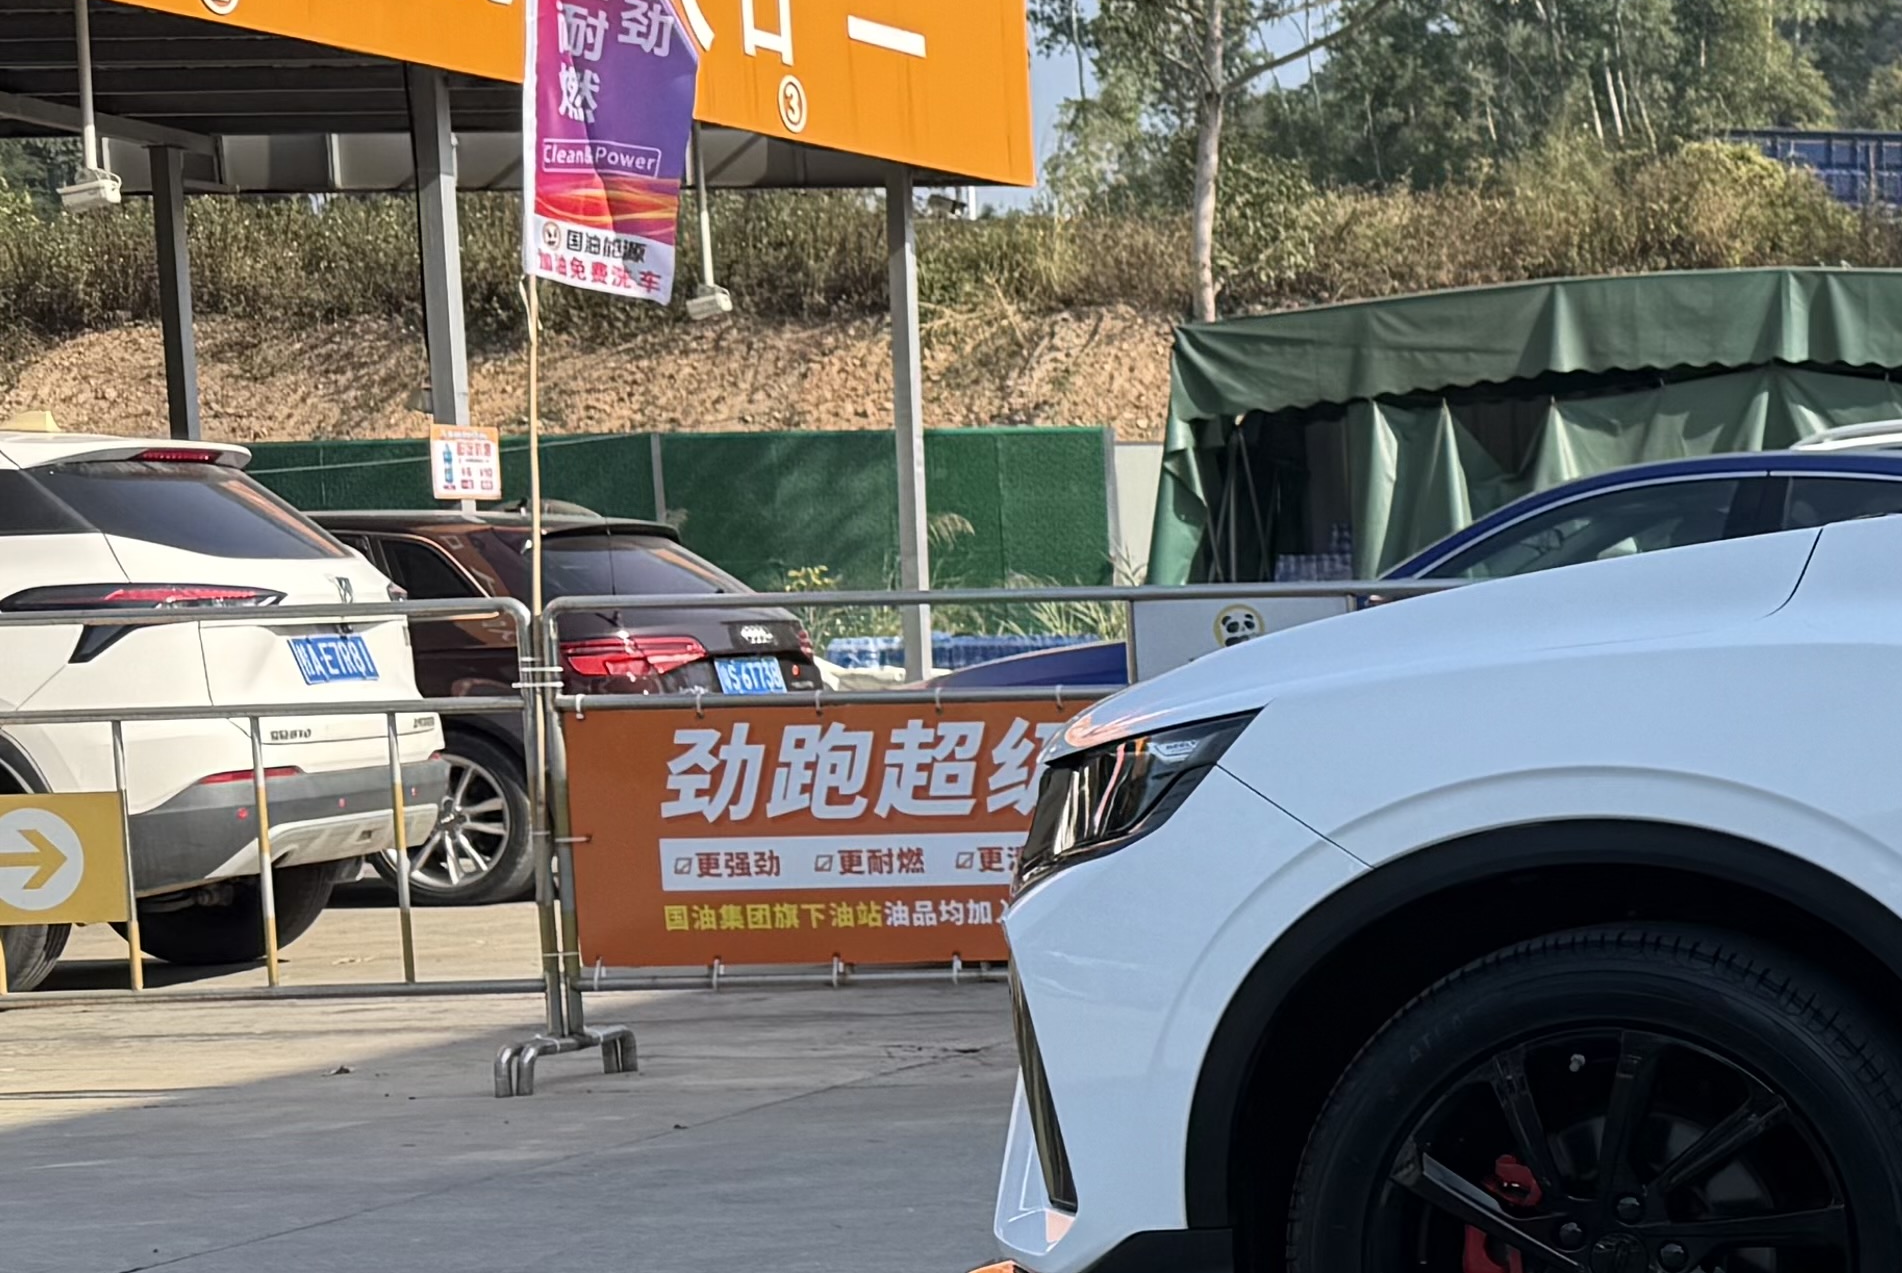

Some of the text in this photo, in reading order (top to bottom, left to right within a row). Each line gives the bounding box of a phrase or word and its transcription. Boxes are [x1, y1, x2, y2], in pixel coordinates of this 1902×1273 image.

[543, 144, 658, 171] Clean&Power
[538, 247, 662, 292] 加油免费洗车
[696, 849, 781, 878] 更强劲
[838, 847, 926, 876] 更耐燃
